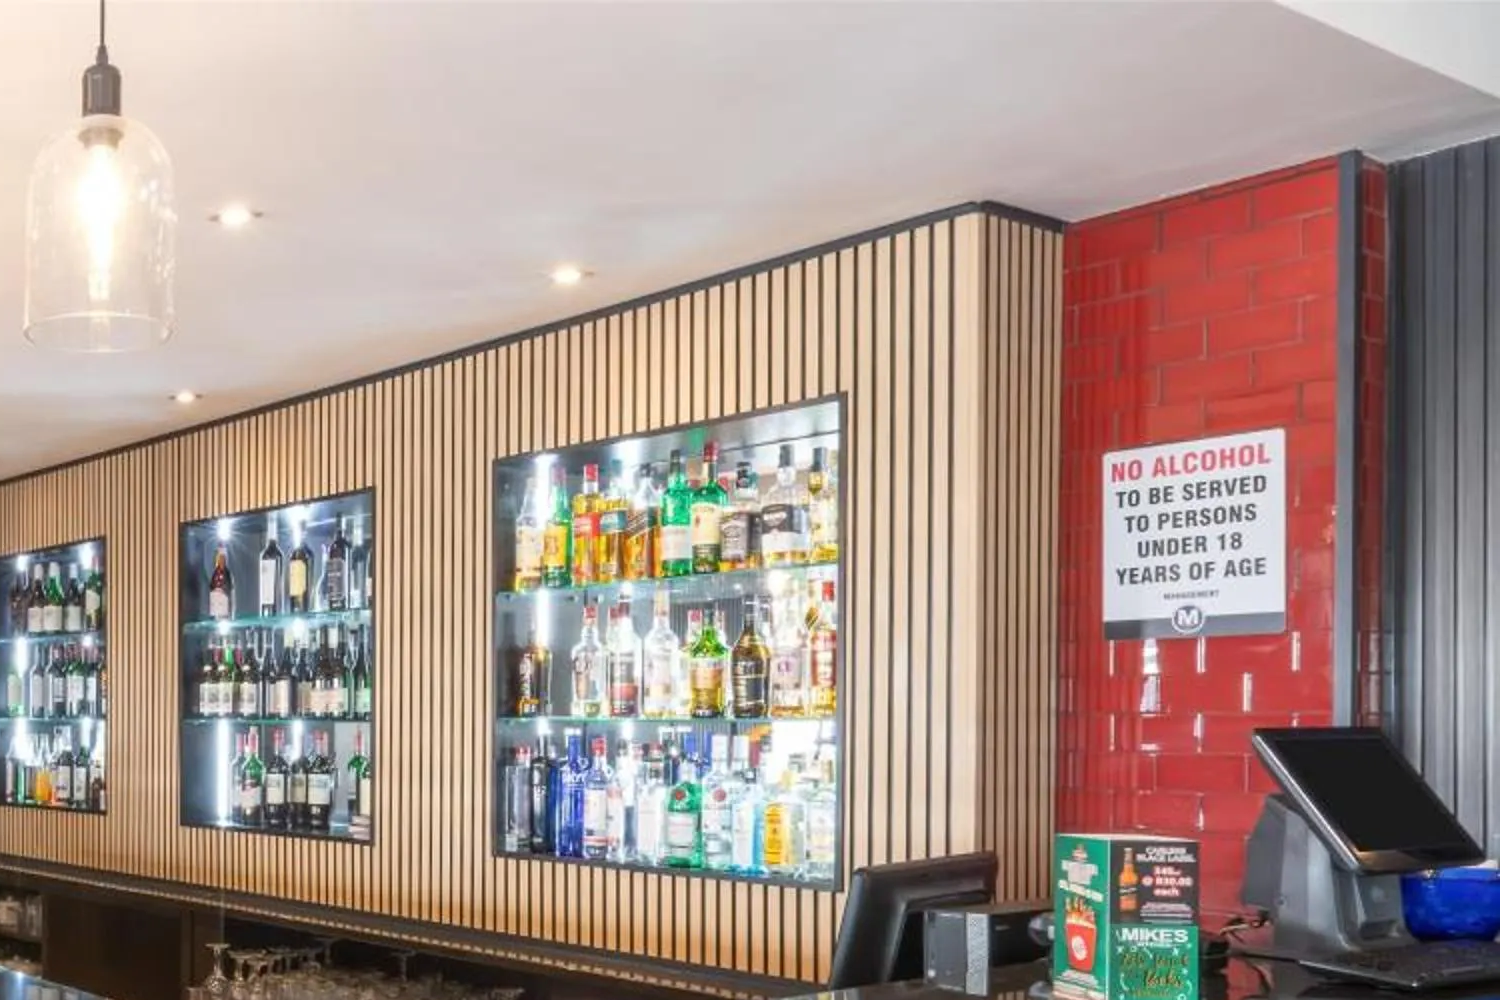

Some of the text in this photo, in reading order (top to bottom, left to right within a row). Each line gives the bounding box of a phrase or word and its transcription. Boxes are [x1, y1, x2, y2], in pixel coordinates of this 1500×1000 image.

[1111, 443, 1271, 483] NO ALCOHOL
[1116, 475, 1267, 508] TO BE SERVED
[1124, 503, 1257, 533] TO PERSONS
[1137, 532, 1243, 559] UNDER 18
[1116, 557, 1267, 586] YEARS OF AGE
[1121, 928, 1188, 943] MIKES
